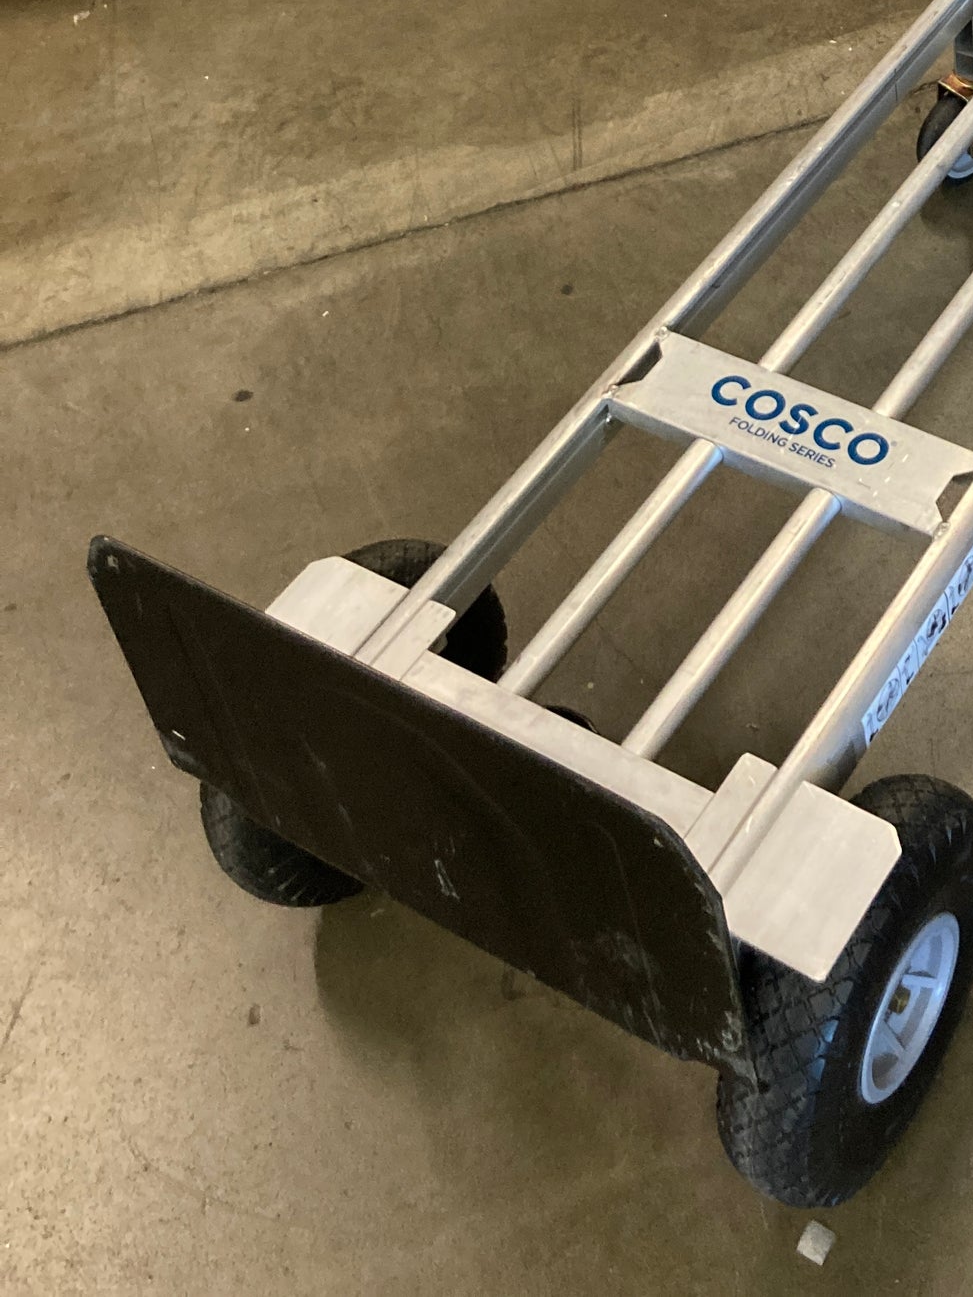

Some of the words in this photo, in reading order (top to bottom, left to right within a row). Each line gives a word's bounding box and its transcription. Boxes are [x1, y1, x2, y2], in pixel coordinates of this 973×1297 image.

[711, 375, 890, 466] COSCO
[729, 416, 788, 448] FOLDING
[788, 441, 837, 469] SERIES
